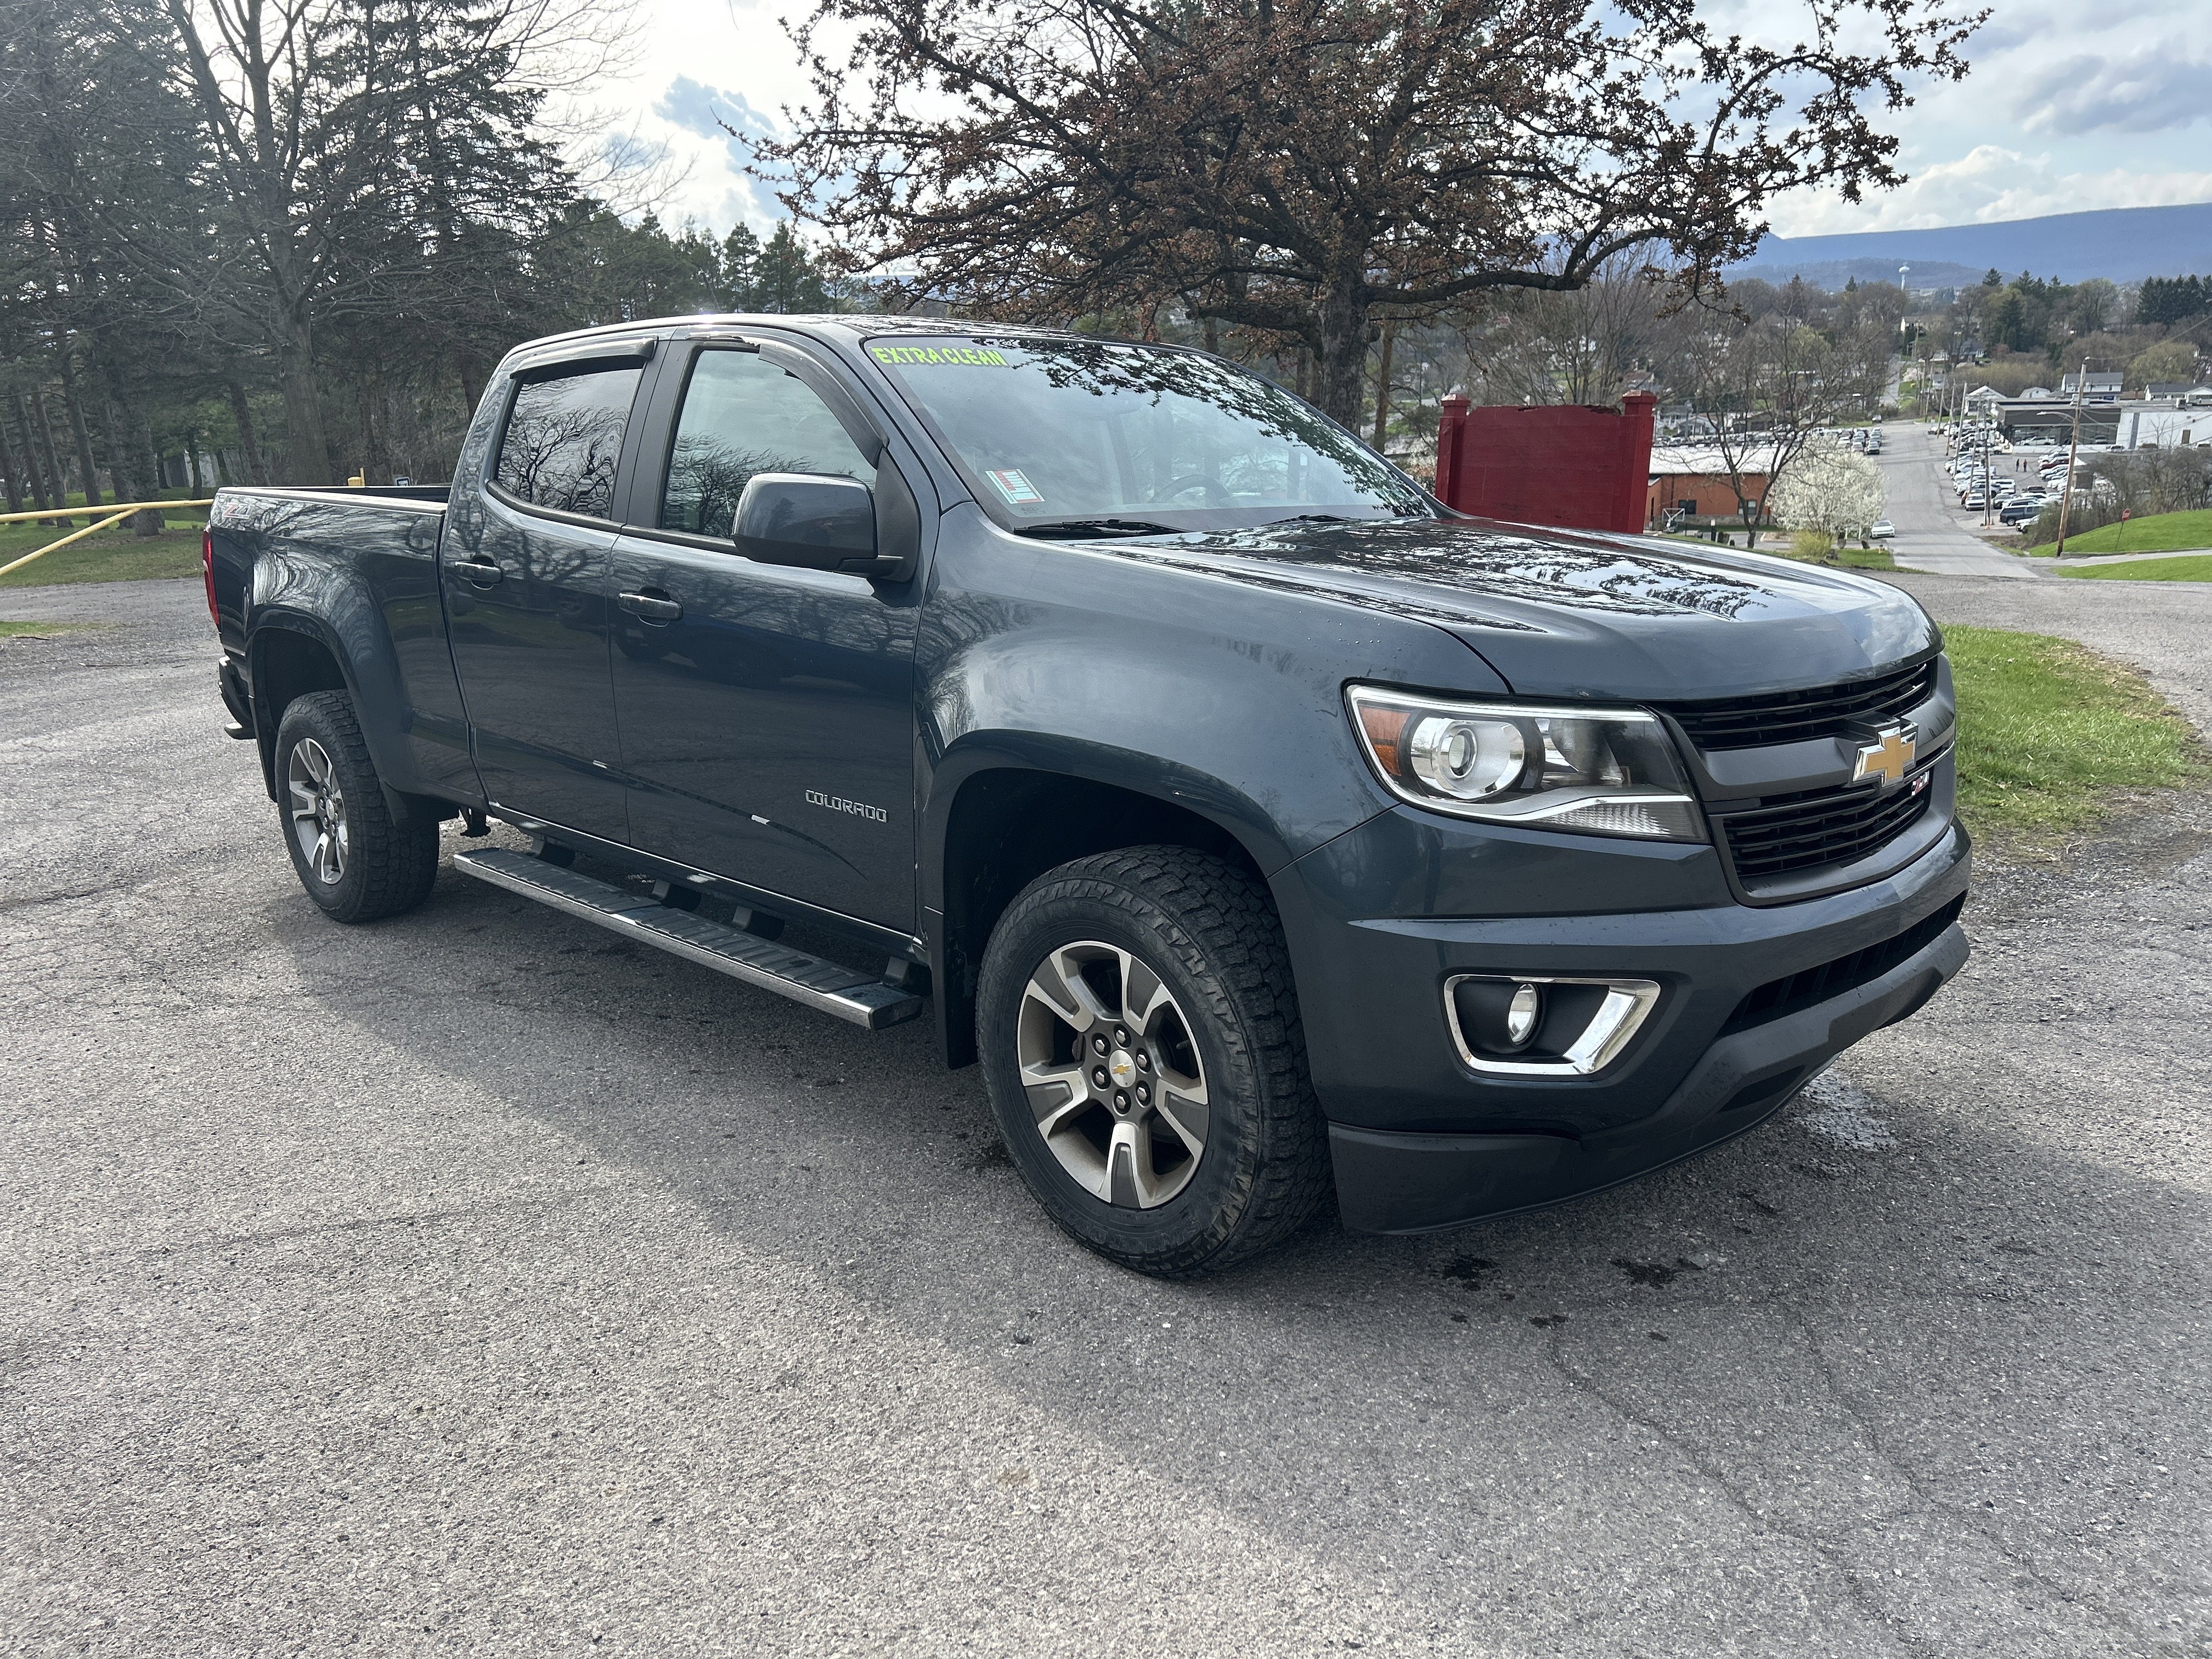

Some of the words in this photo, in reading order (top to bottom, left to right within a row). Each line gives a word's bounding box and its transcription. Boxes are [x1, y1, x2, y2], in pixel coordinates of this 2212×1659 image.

[871, 347, 945, 364] EXTRA
[942, 348, 1008, 366] CLEAN
[223, 503, 255, 519] Z71
[805, 789, 887, 823] COLORADO
